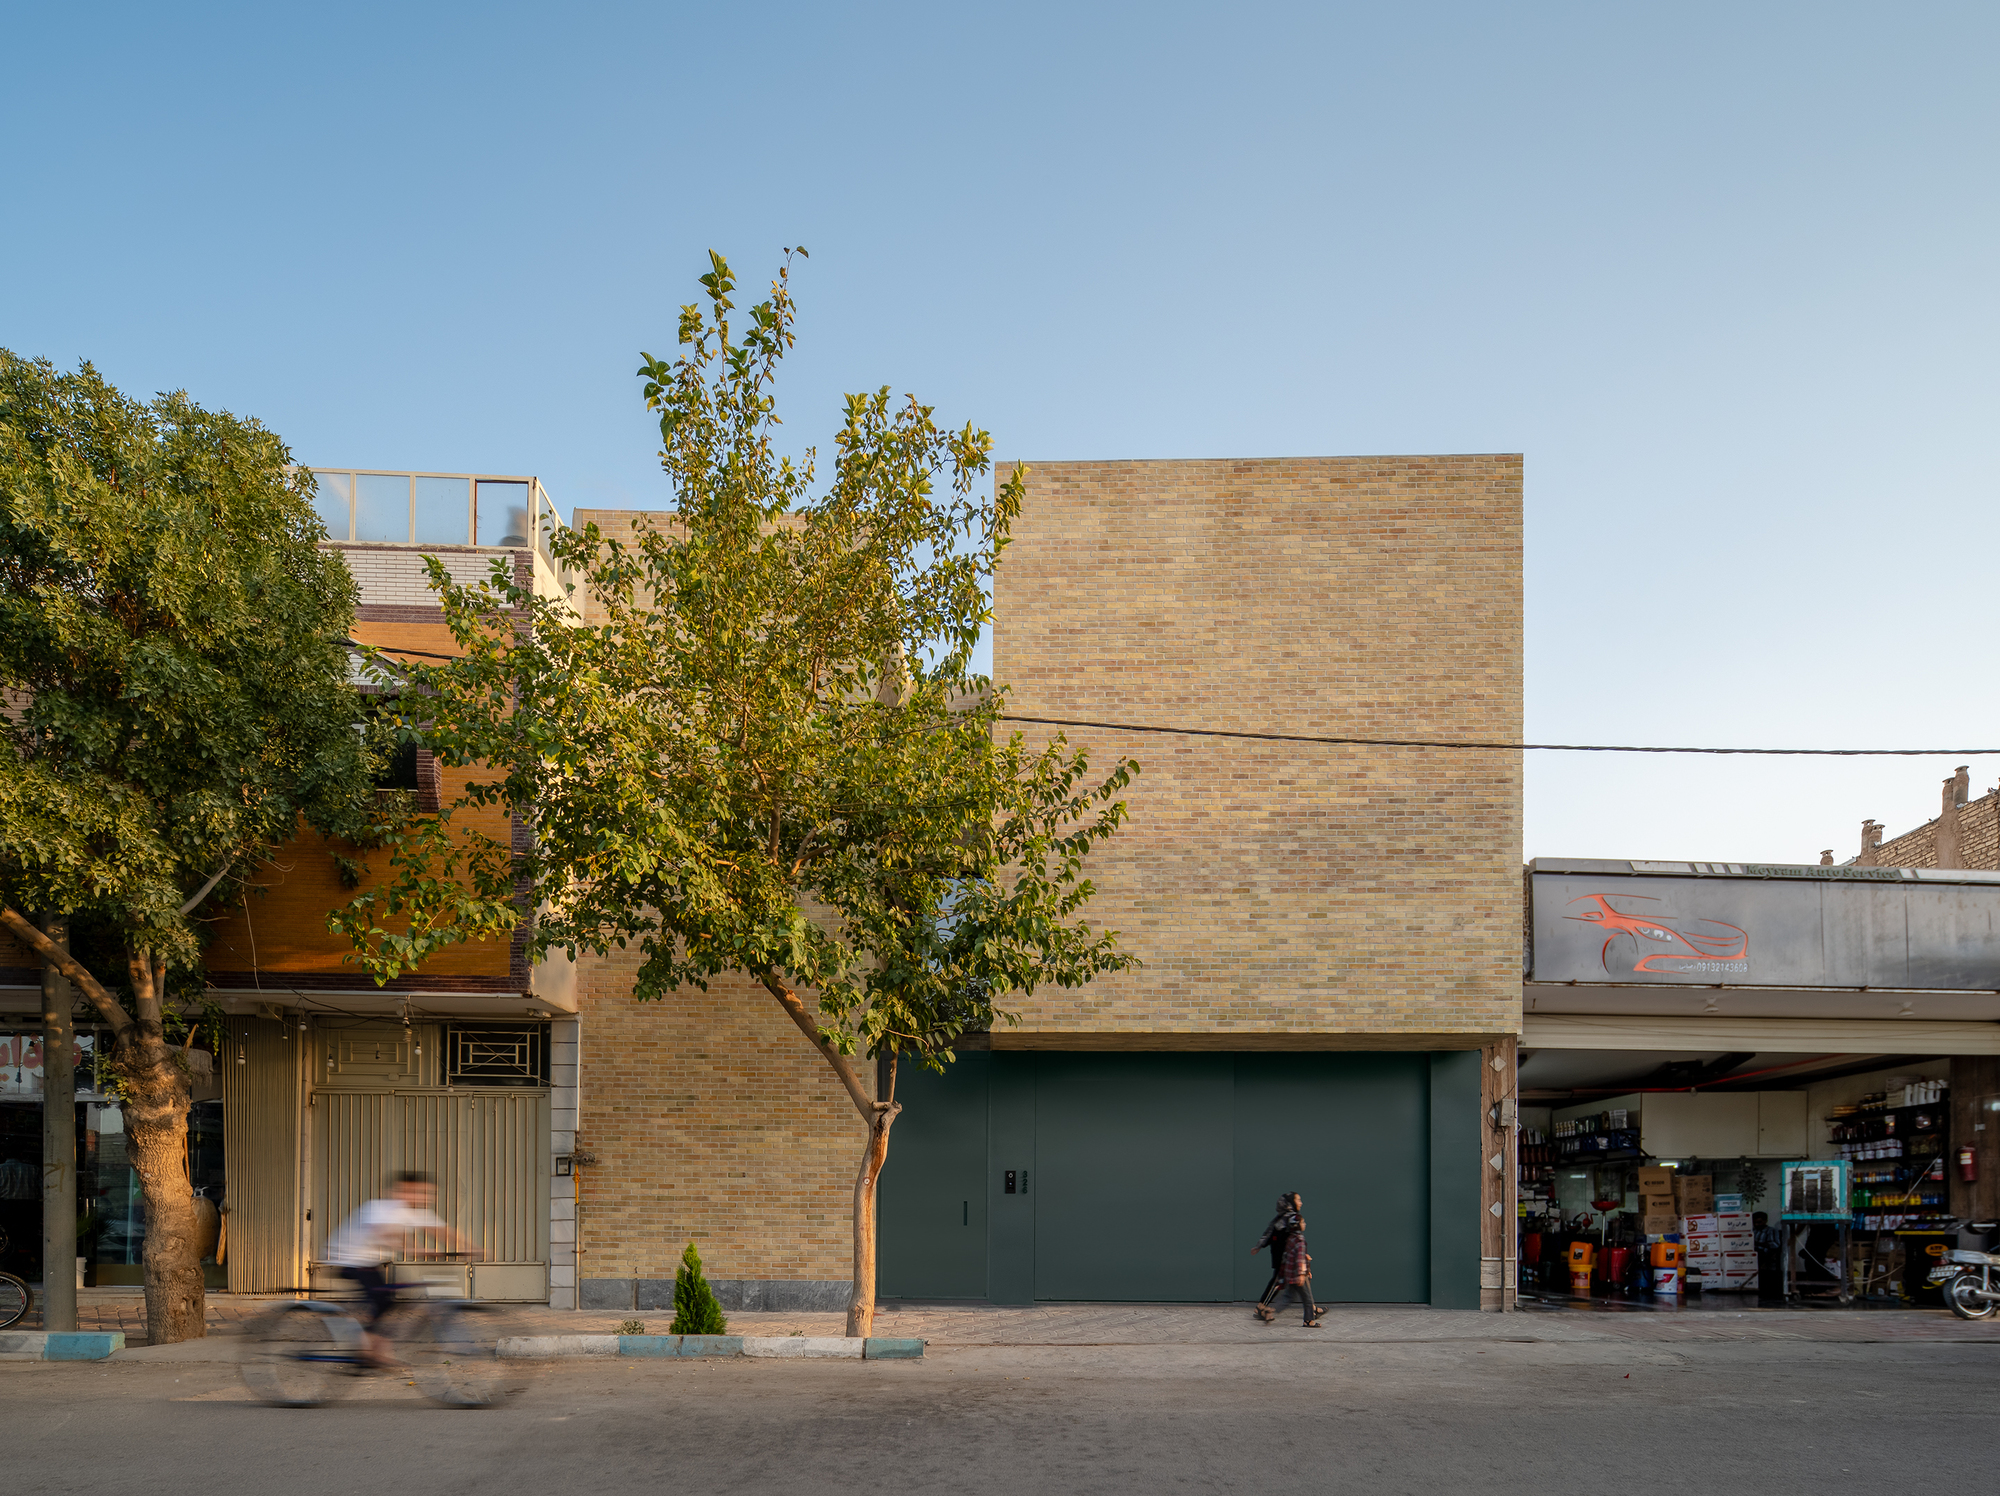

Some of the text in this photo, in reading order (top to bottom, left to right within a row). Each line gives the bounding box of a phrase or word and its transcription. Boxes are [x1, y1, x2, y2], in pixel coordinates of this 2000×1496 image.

[1746, 865, 1898, 879] Meysam Auto Service
